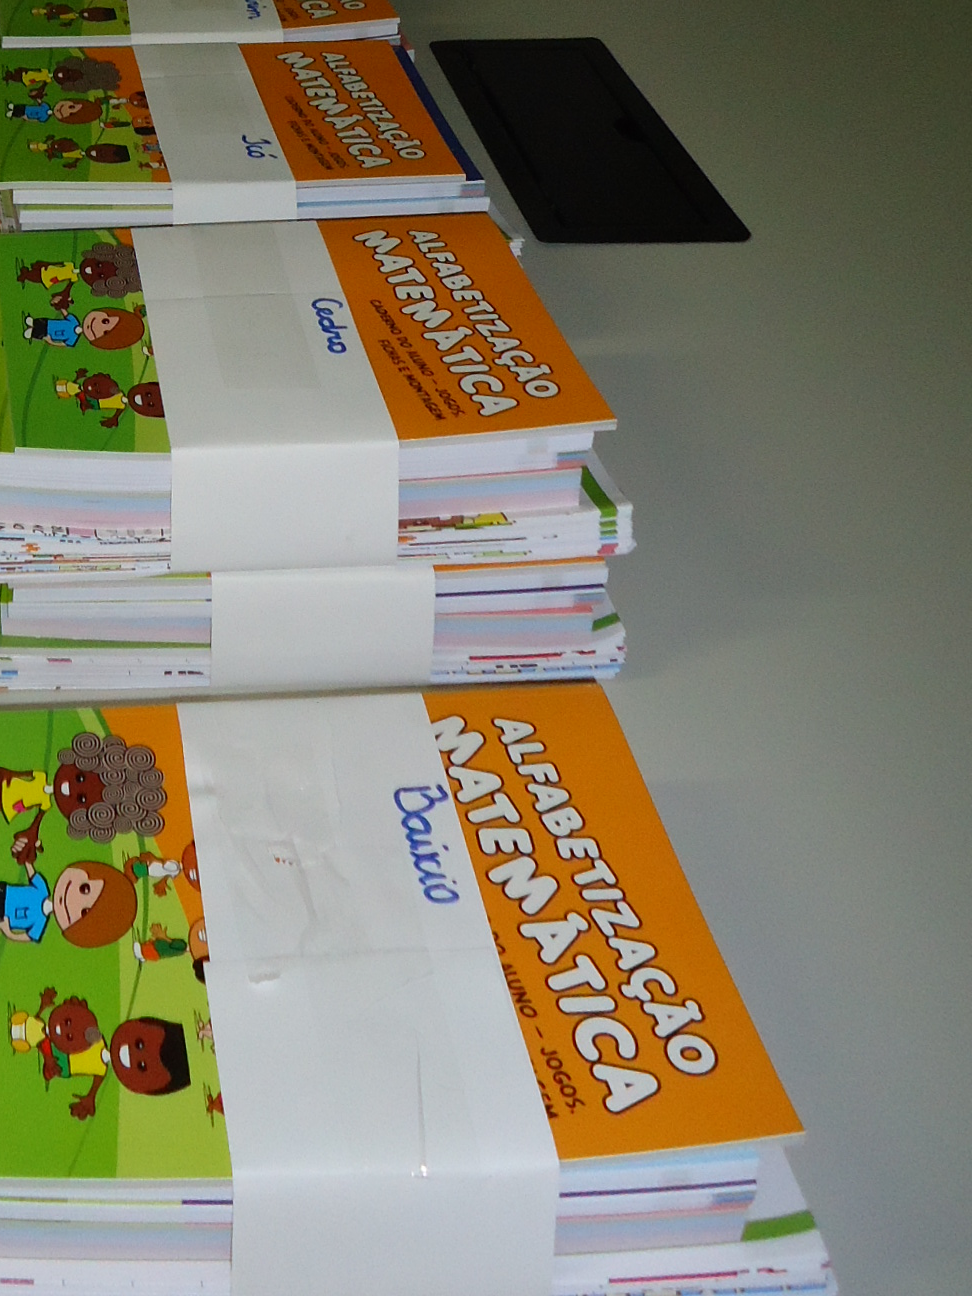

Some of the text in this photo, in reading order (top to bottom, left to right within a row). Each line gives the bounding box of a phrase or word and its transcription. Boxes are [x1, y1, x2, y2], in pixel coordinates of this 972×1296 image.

[277, 51, 392, 169] MATEMÁTICA
[321, 52, 426, 160] ALFABETIZAÇÃO
[311, 297, 347, 354] Cedro
[353, 228, 519, 416] MATEMÁTICA
[407, 229, 560, 398] ALFABETIZAÇÃO
[431, 715, 660, 1113] MATEMÁTICA
[491, 716, 718, 1075] ALFABETIZAÇÃO
[502, 963, 538, 1018] ALUNO
